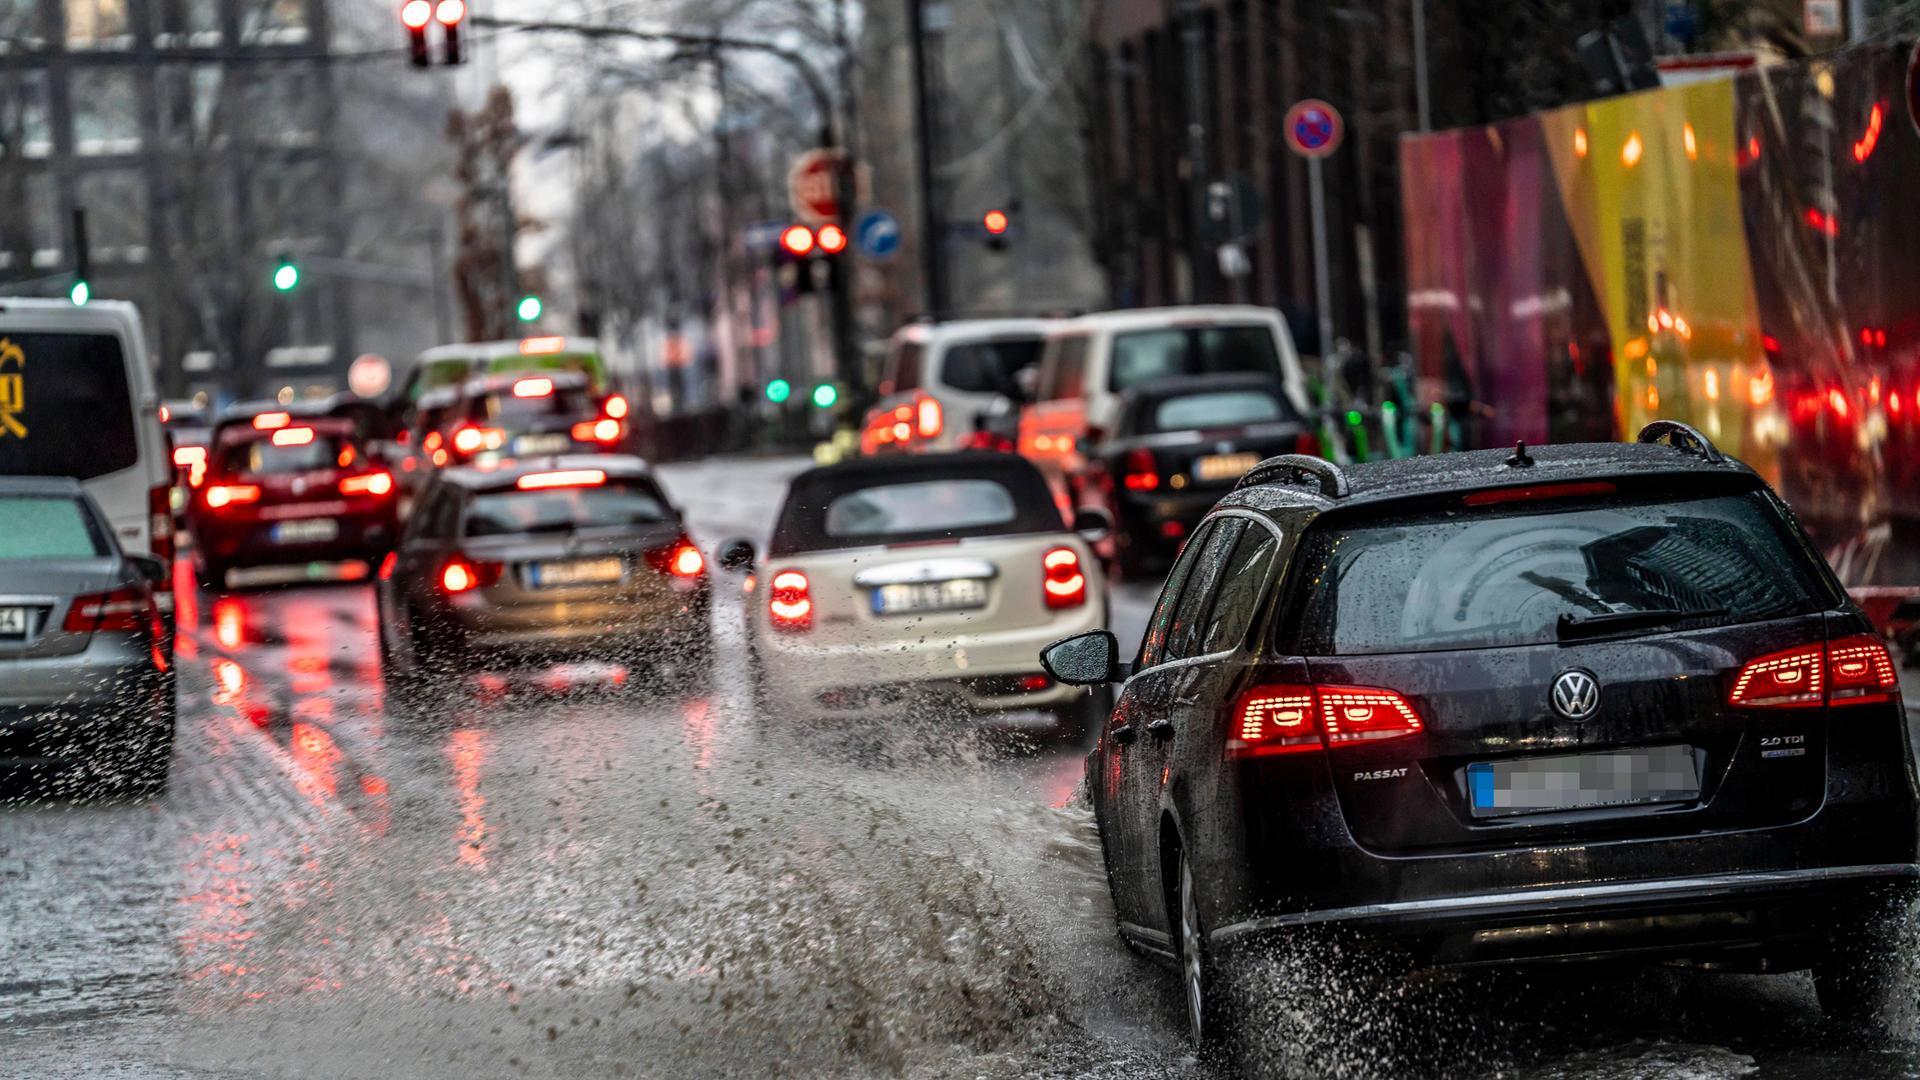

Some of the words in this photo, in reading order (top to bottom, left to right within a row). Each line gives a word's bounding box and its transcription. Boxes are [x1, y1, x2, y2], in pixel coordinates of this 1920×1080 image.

[1553, 672, 1598, 717] VW
[1760, 737, 1781, 746] 2.0
[1782, 735, 1804, 744] TDI
[1353, 767, 1408, 781] PASSAT
